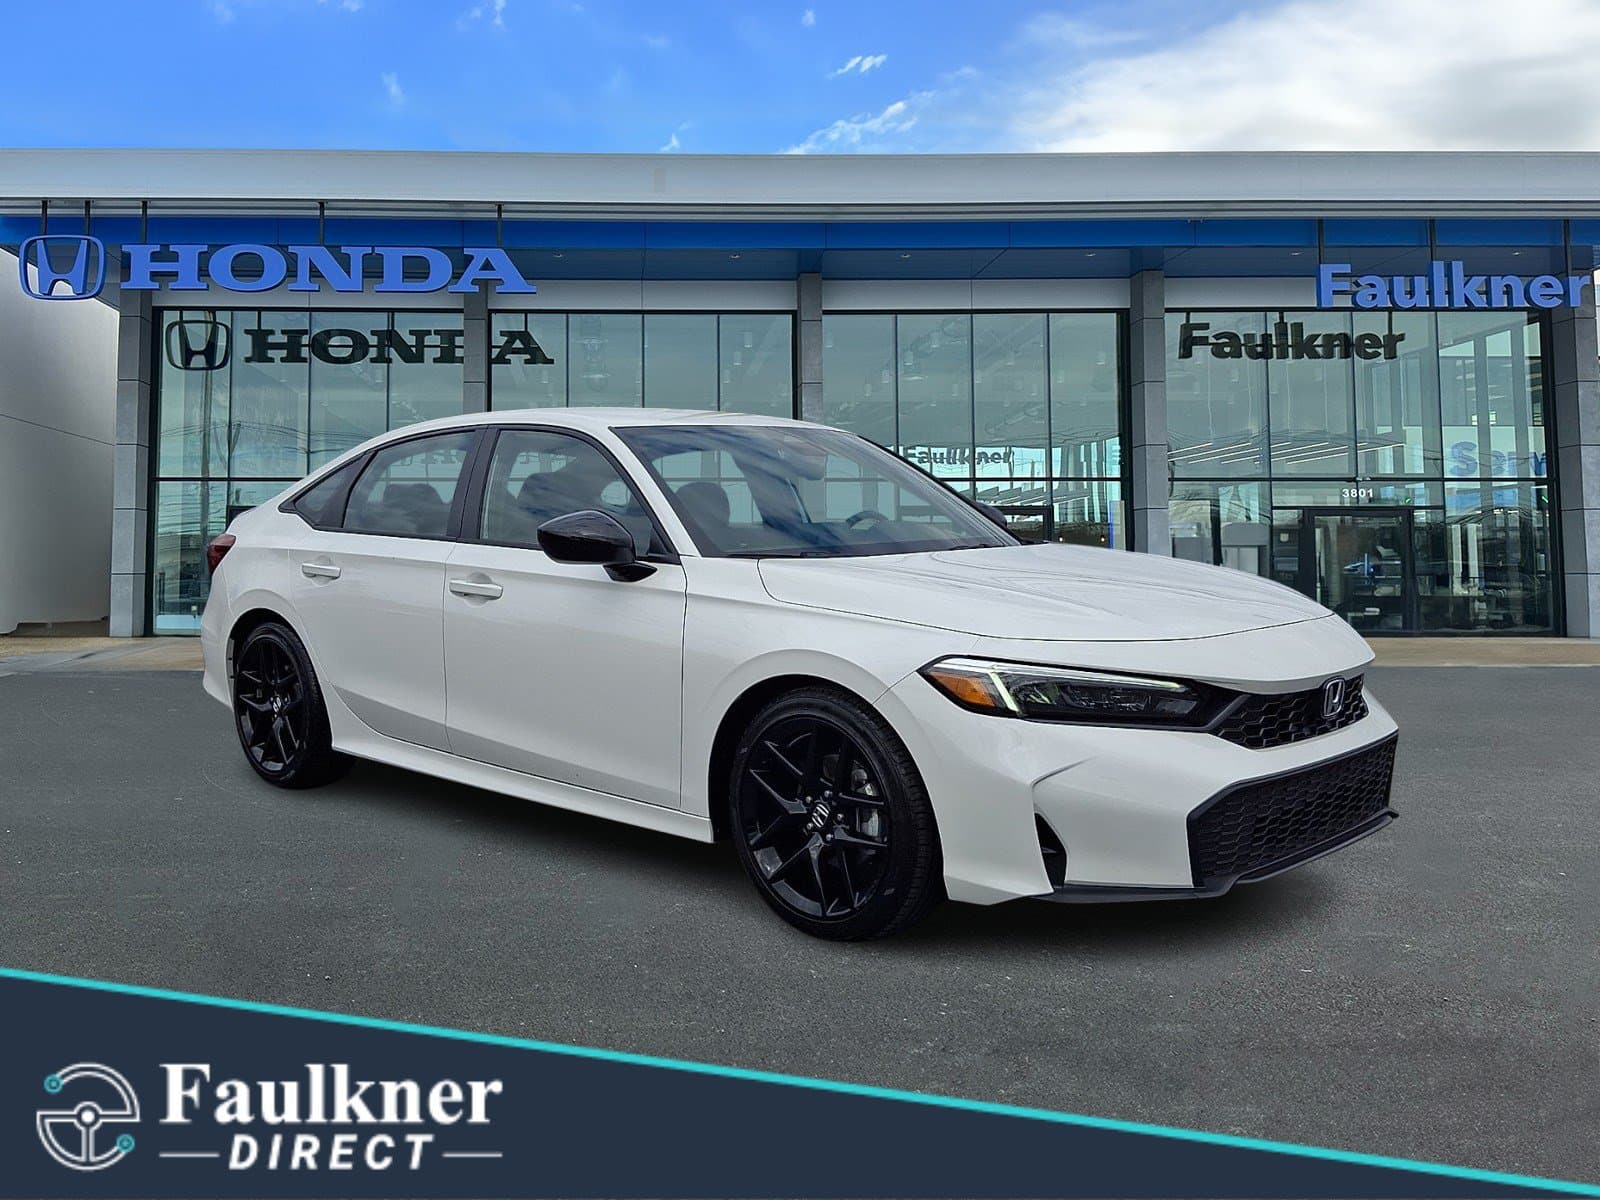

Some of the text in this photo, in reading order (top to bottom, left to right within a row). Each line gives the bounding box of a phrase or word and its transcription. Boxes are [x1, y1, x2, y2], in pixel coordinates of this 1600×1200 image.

[121, 243, 537, 294] HONDA
[1316, 260, 1592, 310] Faulkner
[1178, 321, 1406, 361] Faulkner
[1342, 488, 1374, 498] 3801
